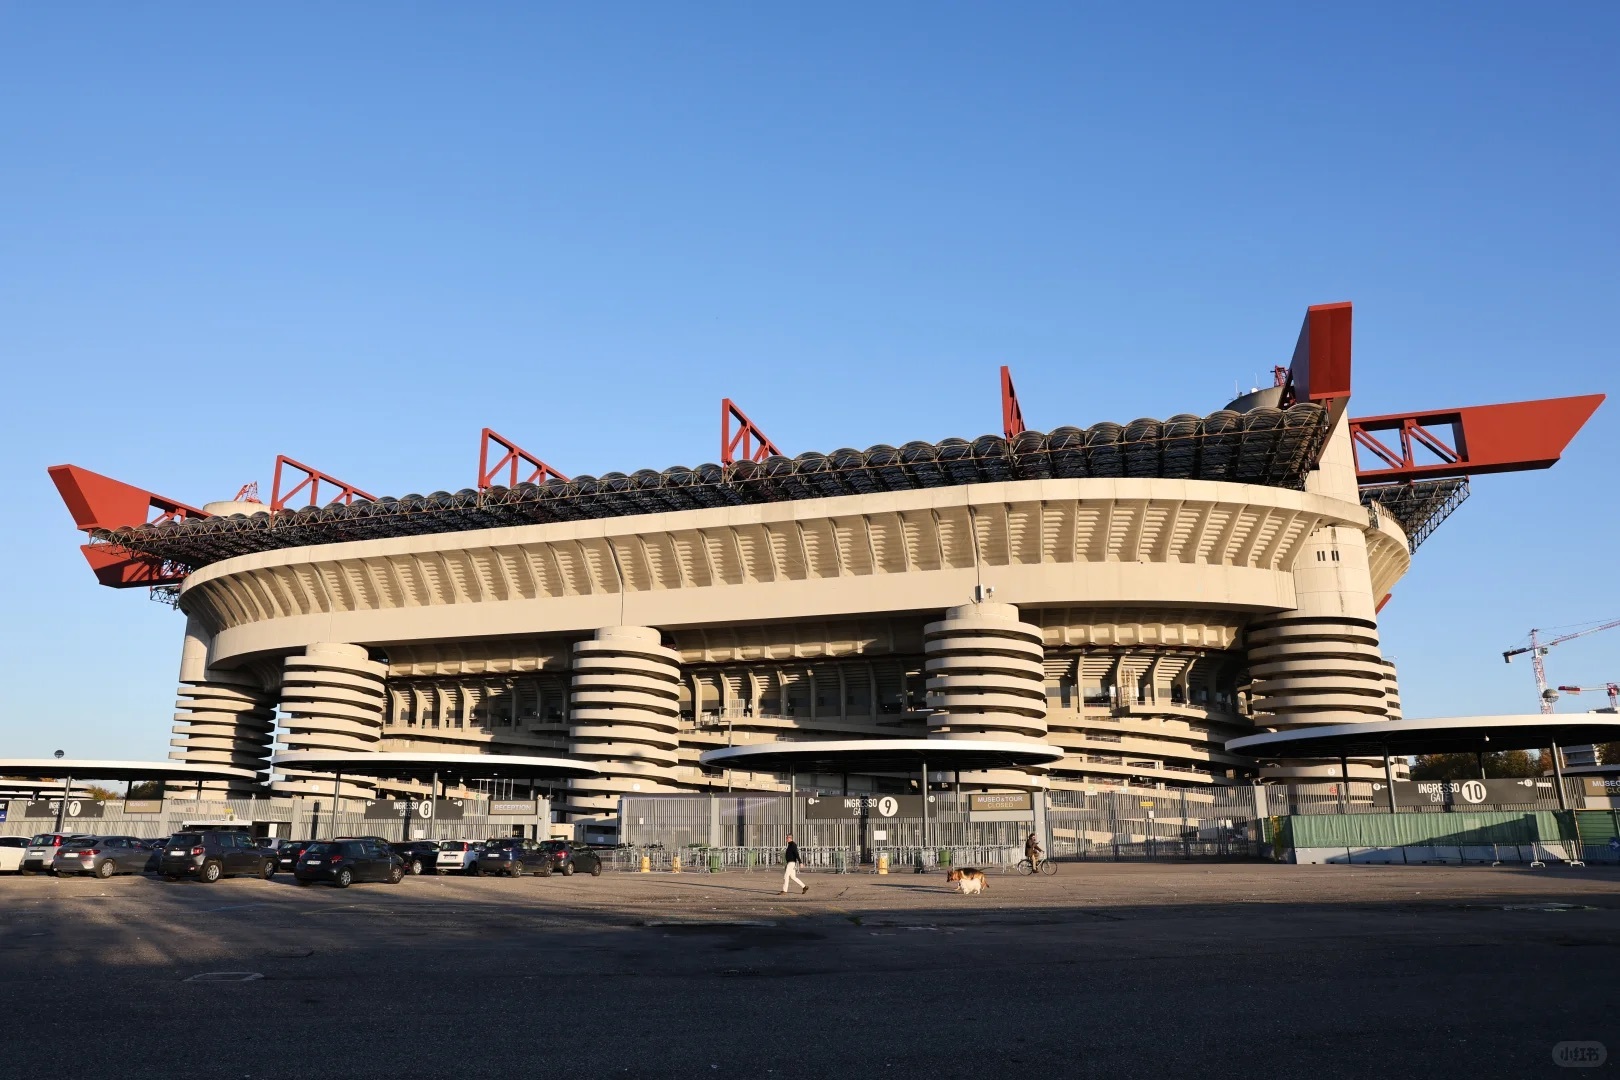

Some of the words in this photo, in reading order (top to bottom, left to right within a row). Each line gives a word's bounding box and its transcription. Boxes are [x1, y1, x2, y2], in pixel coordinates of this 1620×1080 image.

[1418, 783, 1460, 794] INGRESSO
[1465, 784, 1483, 800] 10
[393, 801, 419, 810] INGRESSO
[423, 803, 429, 815] 8
[844, 799, 877, 808] INGRESSO
[885, 799, 892, 814] 9
[853, 807, 868, 816] GATE
